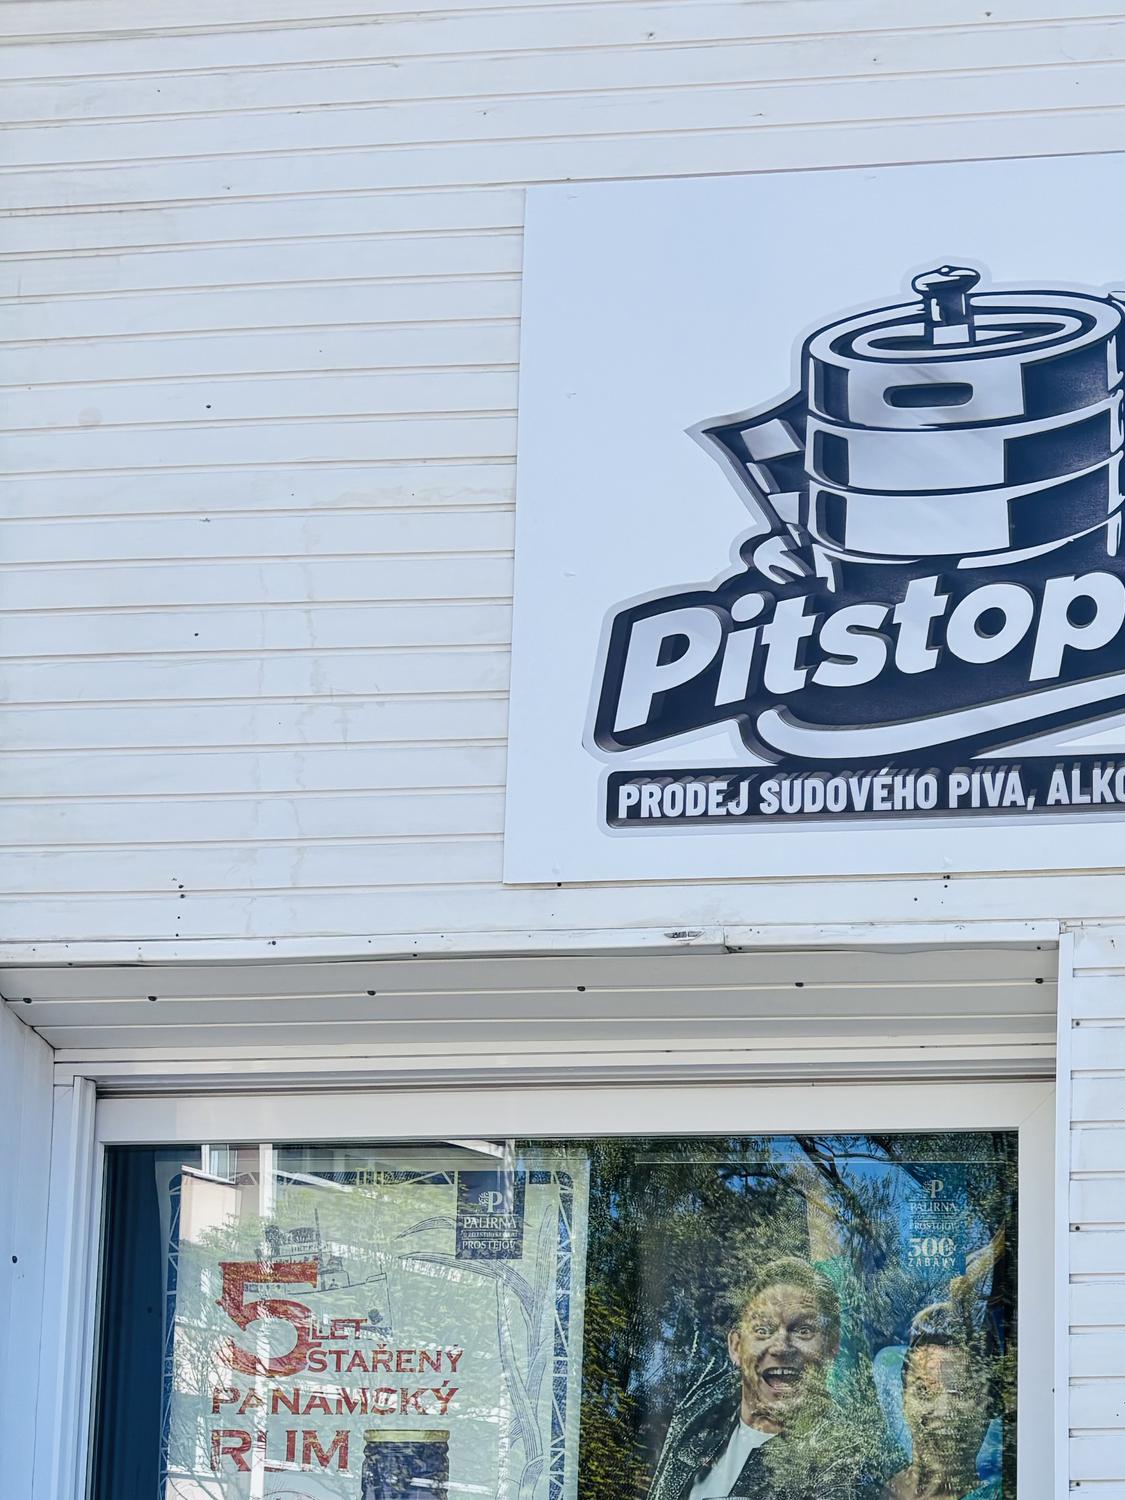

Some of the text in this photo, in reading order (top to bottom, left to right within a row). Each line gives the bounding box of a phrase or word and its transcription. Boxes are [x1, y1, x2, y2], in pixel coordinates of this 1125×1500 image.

[618, 780, 748, 819] PRODEJ
[759, 768, 938, 815] SUDOVÉHO
[948, 771, 1035, 811] PIVA,
[217, 1261, 318, 1379] 5
[311, 1318, 368, 1341] LET
[308, 1343, 464, 1373] STAŘENÝ
